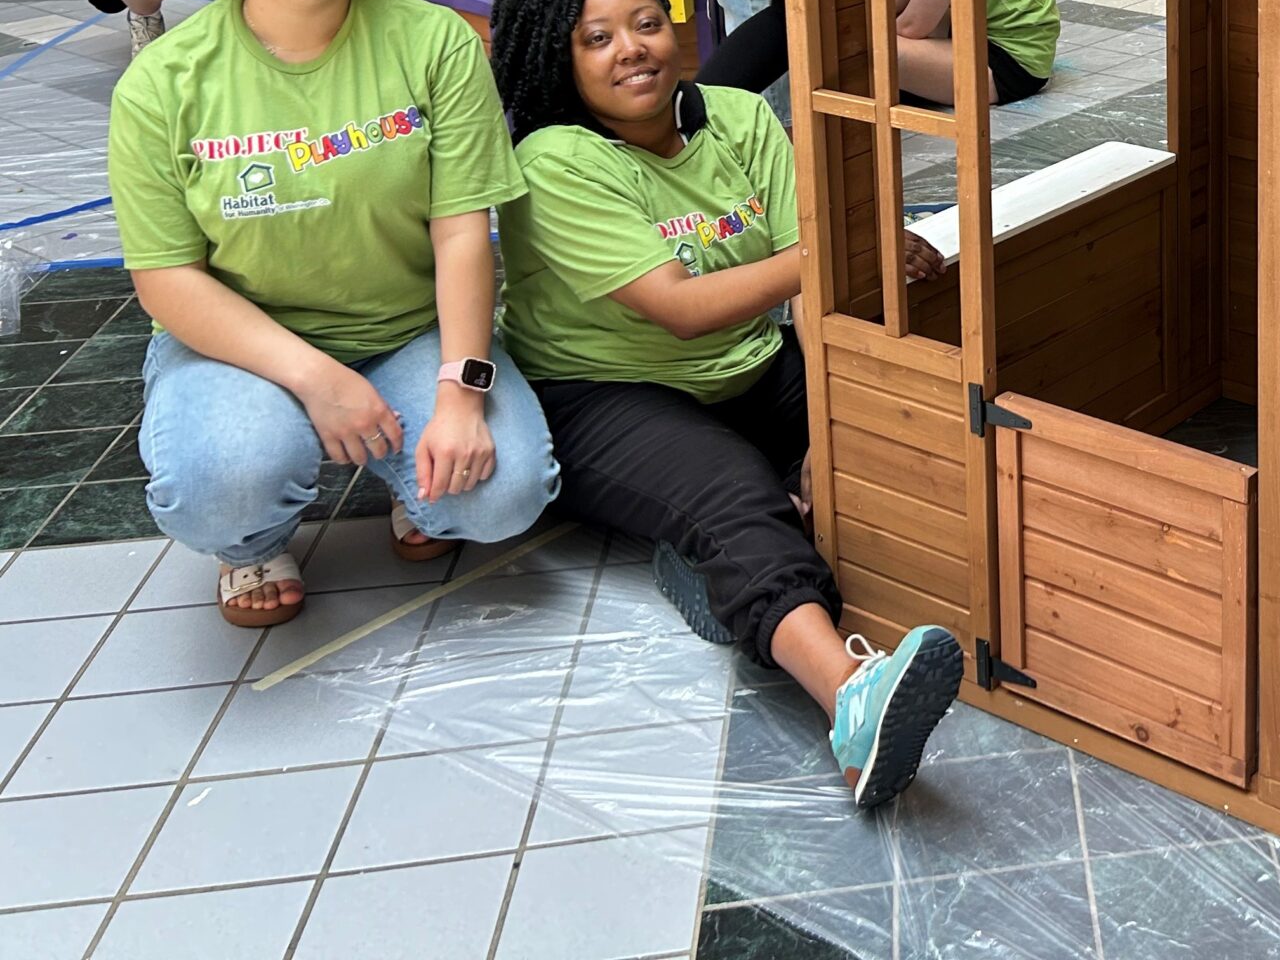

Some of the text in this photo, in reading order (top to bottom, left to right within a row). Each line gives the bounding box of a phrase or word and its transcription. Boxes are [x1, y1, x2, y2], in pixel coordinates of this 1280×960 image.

[192, 129, 308, 161] PROJECT
[223, 194, 274, 210] Habitat
[238, 207, 275, 217] Humanity
